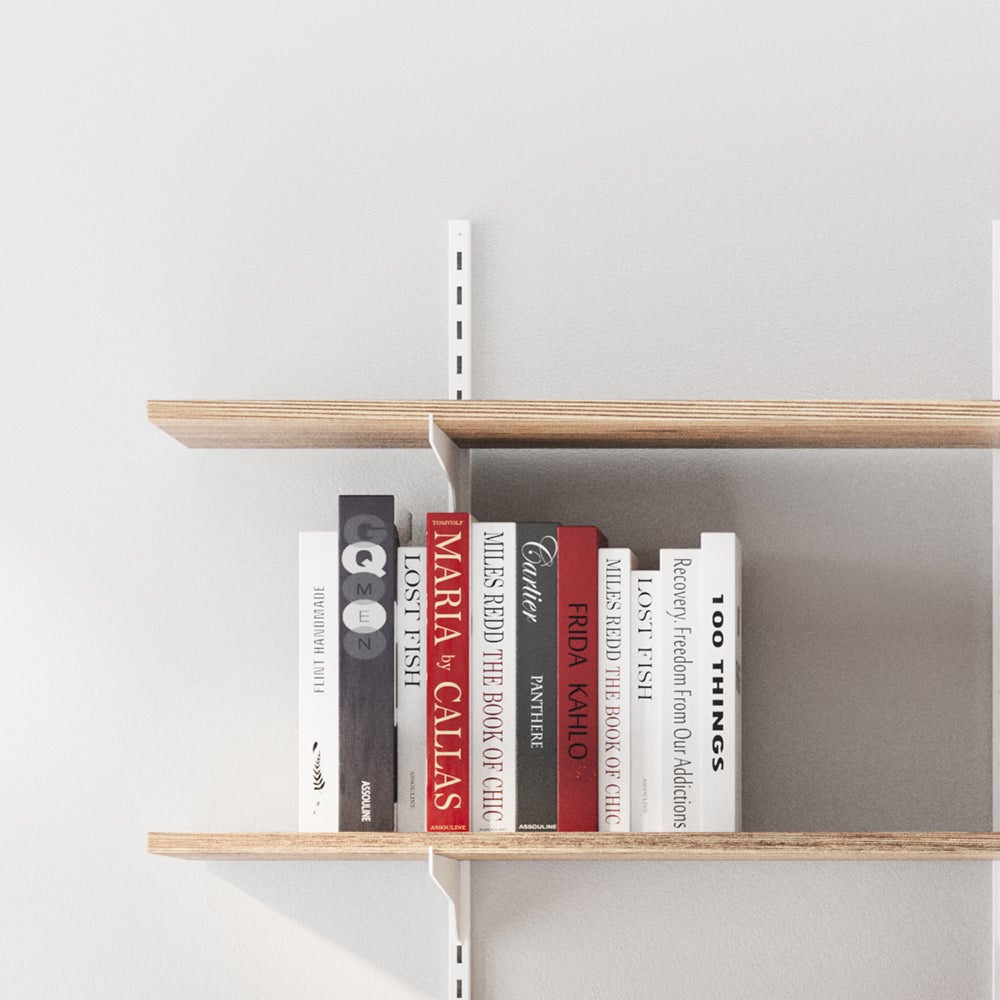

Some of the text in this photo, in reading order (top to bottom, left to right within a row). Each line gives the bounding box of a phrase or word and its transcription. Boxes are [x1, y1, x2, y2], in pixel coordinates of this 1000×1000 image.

[483, 532, 504, 589] MILES
[521, 535, 558, 624] Cartier
[313, 585, 325, 693] FLINT HANDMADE
[404, 553, 421, 688] LOST FISH
[483, 593, 504, 643] REDD
[637, 578, 653, 700] LOST FISH
[433, 532, 462, 810] MARIA by CALLAS
[483, 649, 504, 686] THE
[568, 603, 588, 760] FRIDA KAHLO
[673, 627, 692, 686] Freedom
[712, 593, 724, 772] 100 THINGS
[482, 692, 504, 742] BOOK
[530, 675, 544, 749] PANTHERE
[605, 559, 622, 825] MILES REDD THE BOOK OF CHIC
[673, 691, 692, 725] From
[482, 746, 504, 772] OF
[673, 729, 692, 755] Our
[361, 781, 371, 822] ASSOULINE
[482, 776, 504, 822] CHIC
[673, 757, 692, 829] Addictions
